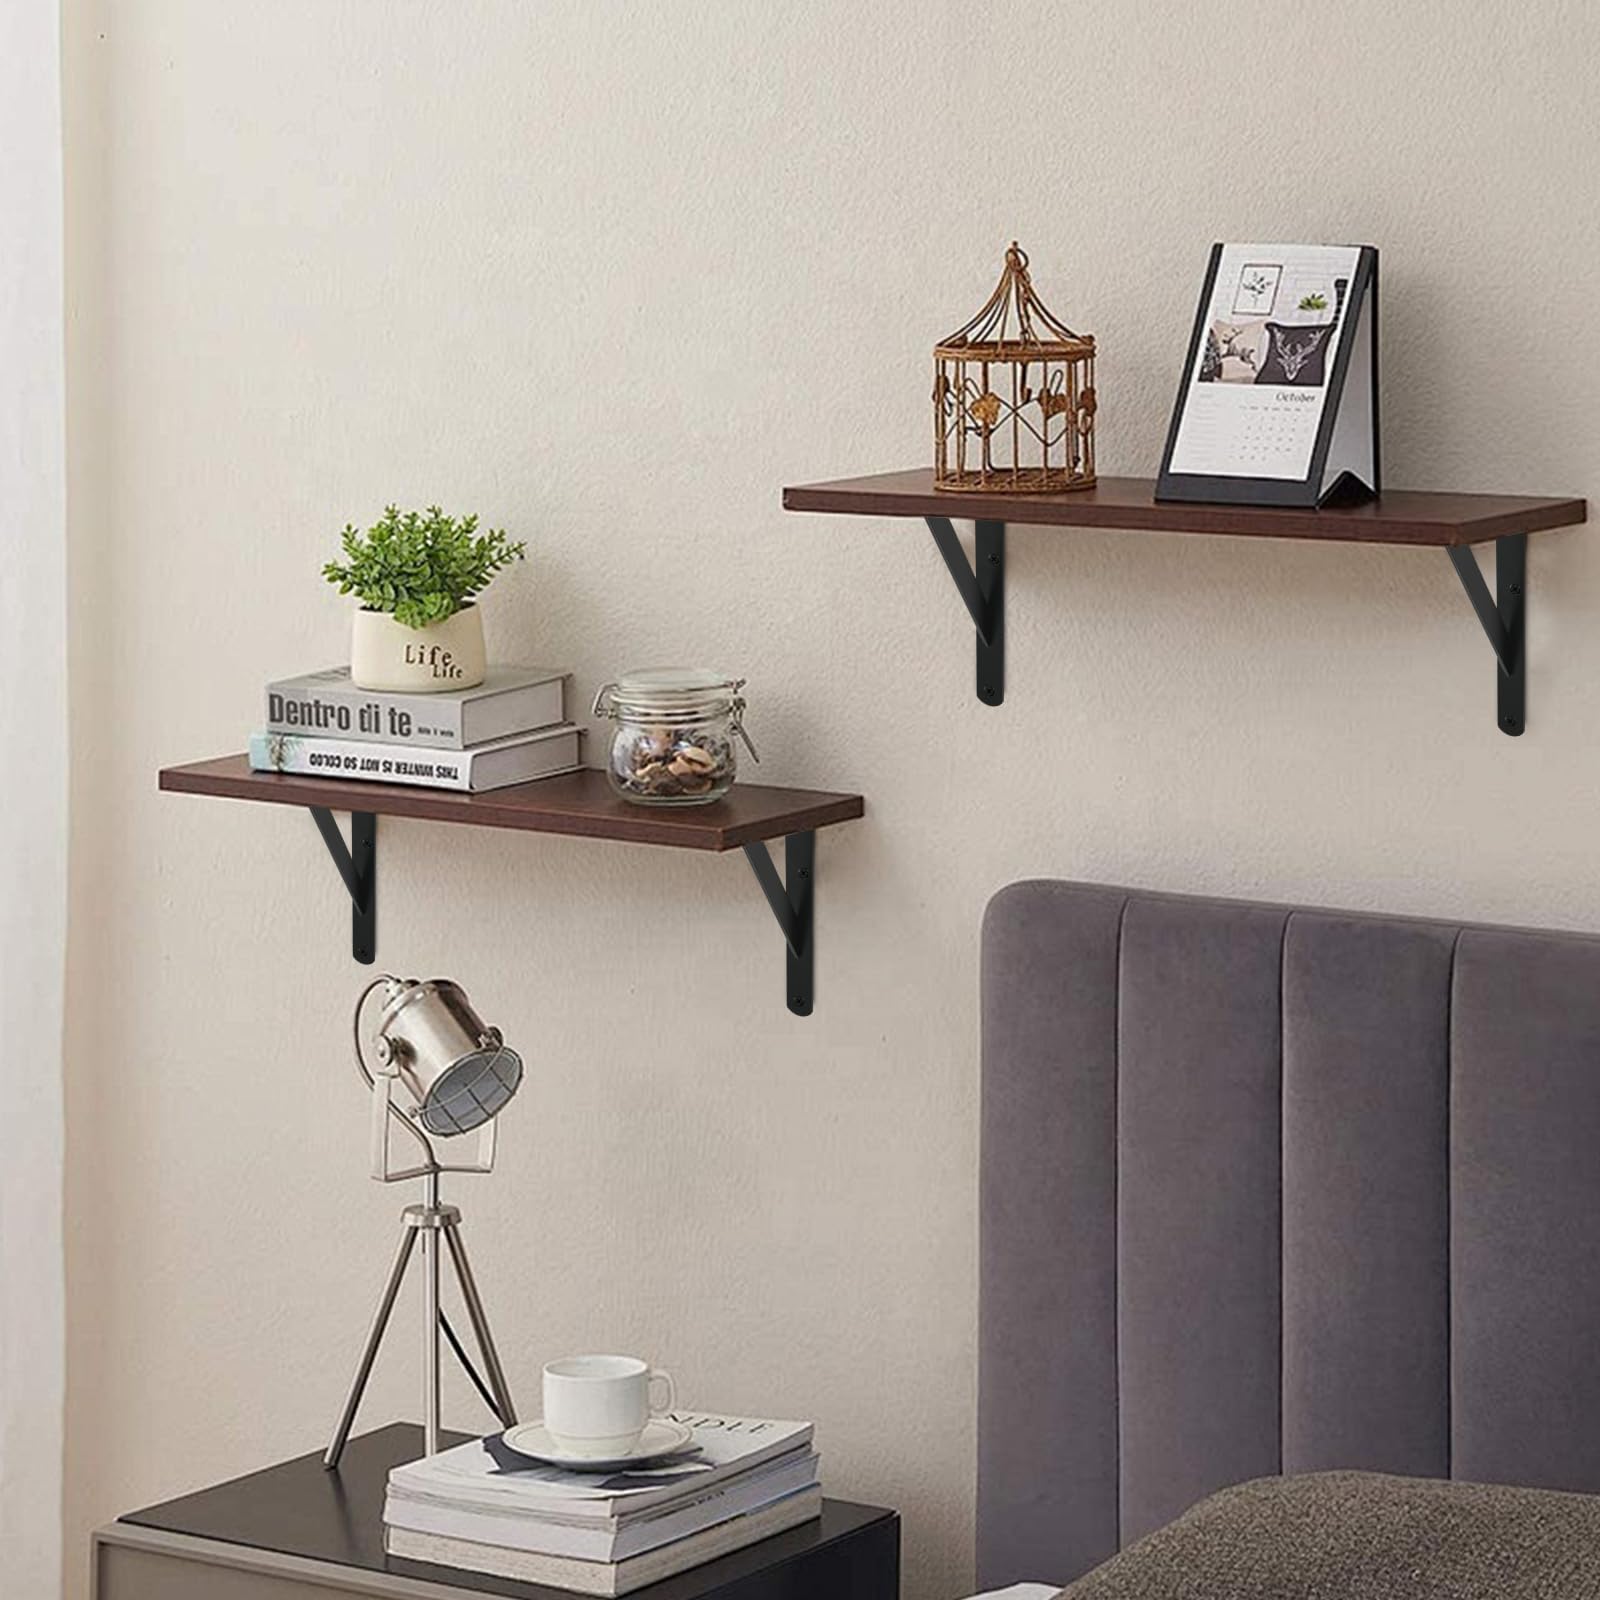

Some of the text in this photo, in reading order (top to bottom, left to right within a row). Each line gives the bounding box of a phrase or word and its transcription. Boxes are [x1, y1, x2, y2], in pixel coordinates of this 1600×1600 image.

[1275, 393, 1315, 403] October
[406, 644, 452, 667] Life
[433, 664, 462, 679] Life
[269, 694, 411, 737] Dentro di te
[344, 757, 359, 770] SO
[359, 758, 380, 772] NOT
[382, 760, 393, 773] IS
[395, 761, 434, 777] WINTER
[436, 765, 459, 780] THIS
